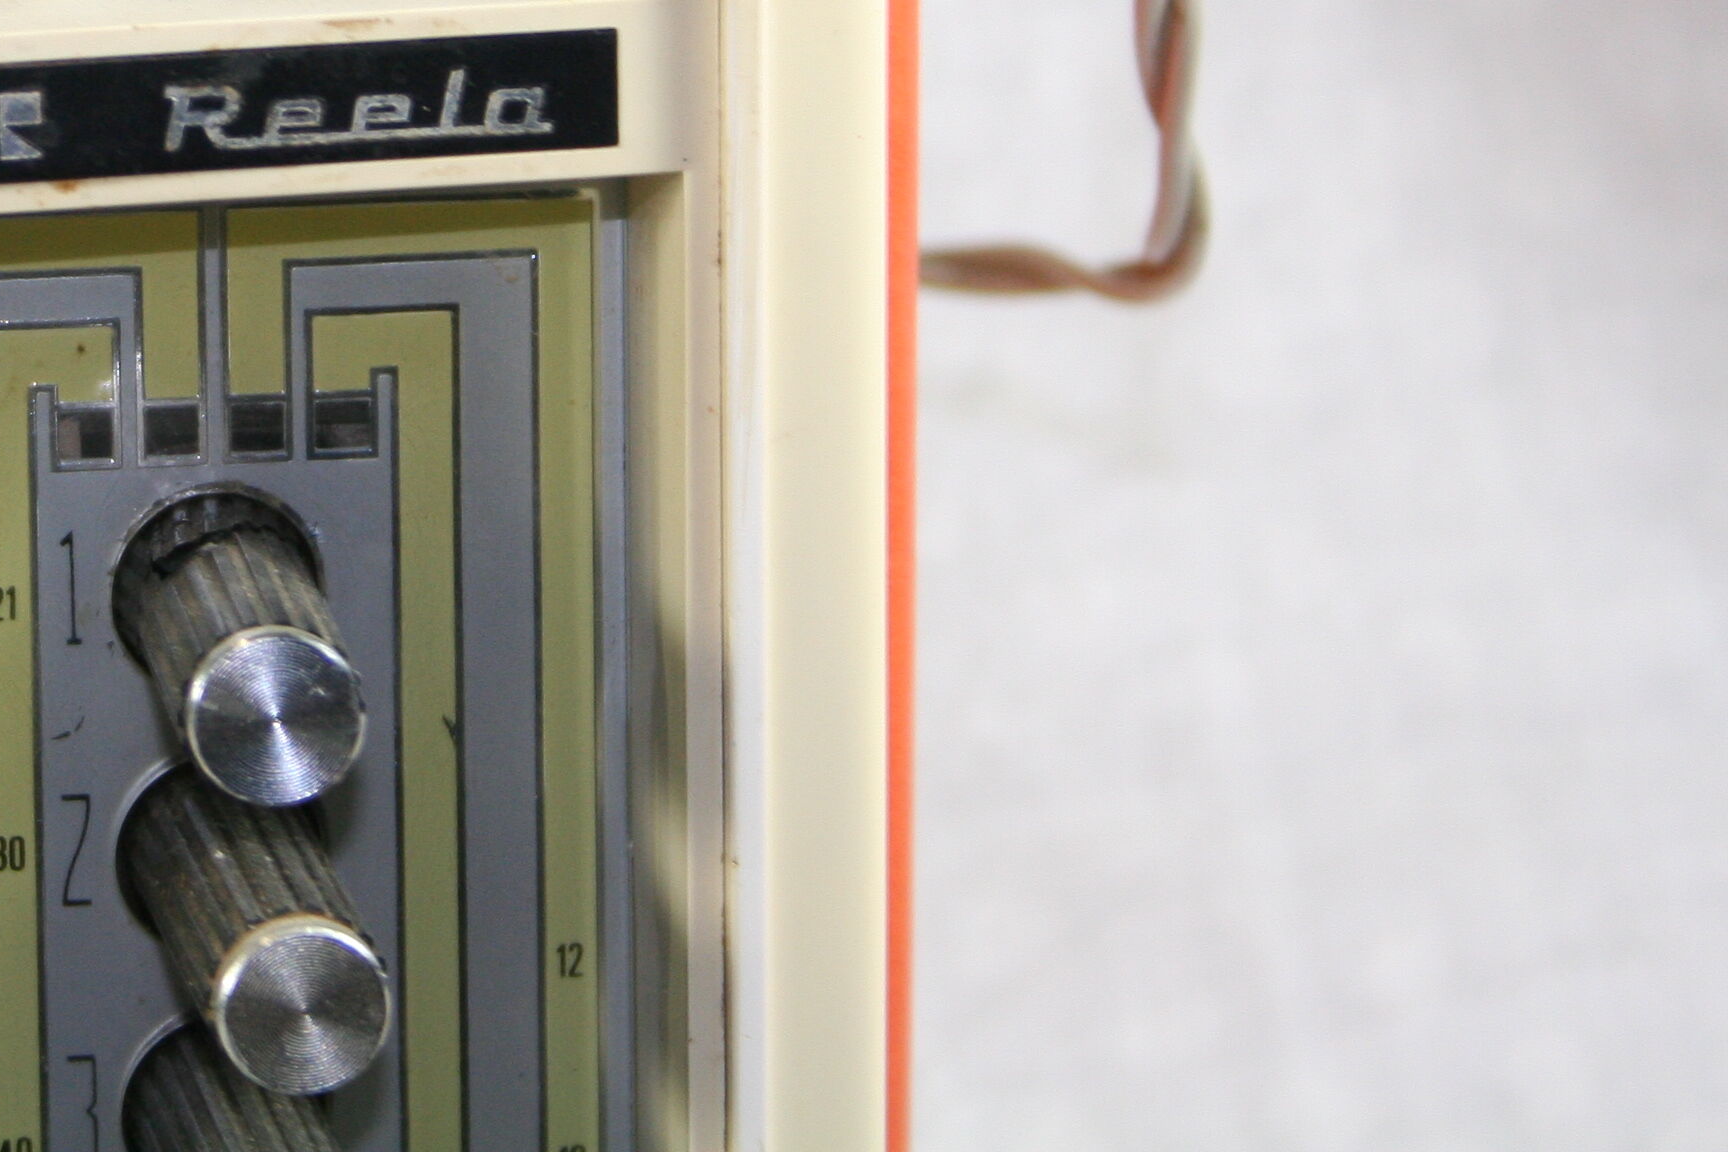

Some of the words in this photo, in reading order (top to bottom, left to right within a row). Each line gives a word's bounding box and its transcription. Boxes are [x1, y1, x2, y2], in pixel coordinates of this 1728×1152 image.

[164, 68, 553, 151] Reela
[60, 530, 82, 645] 1
[61, 794, 92, 907] 2
[556, 942, 584, 978] 12
